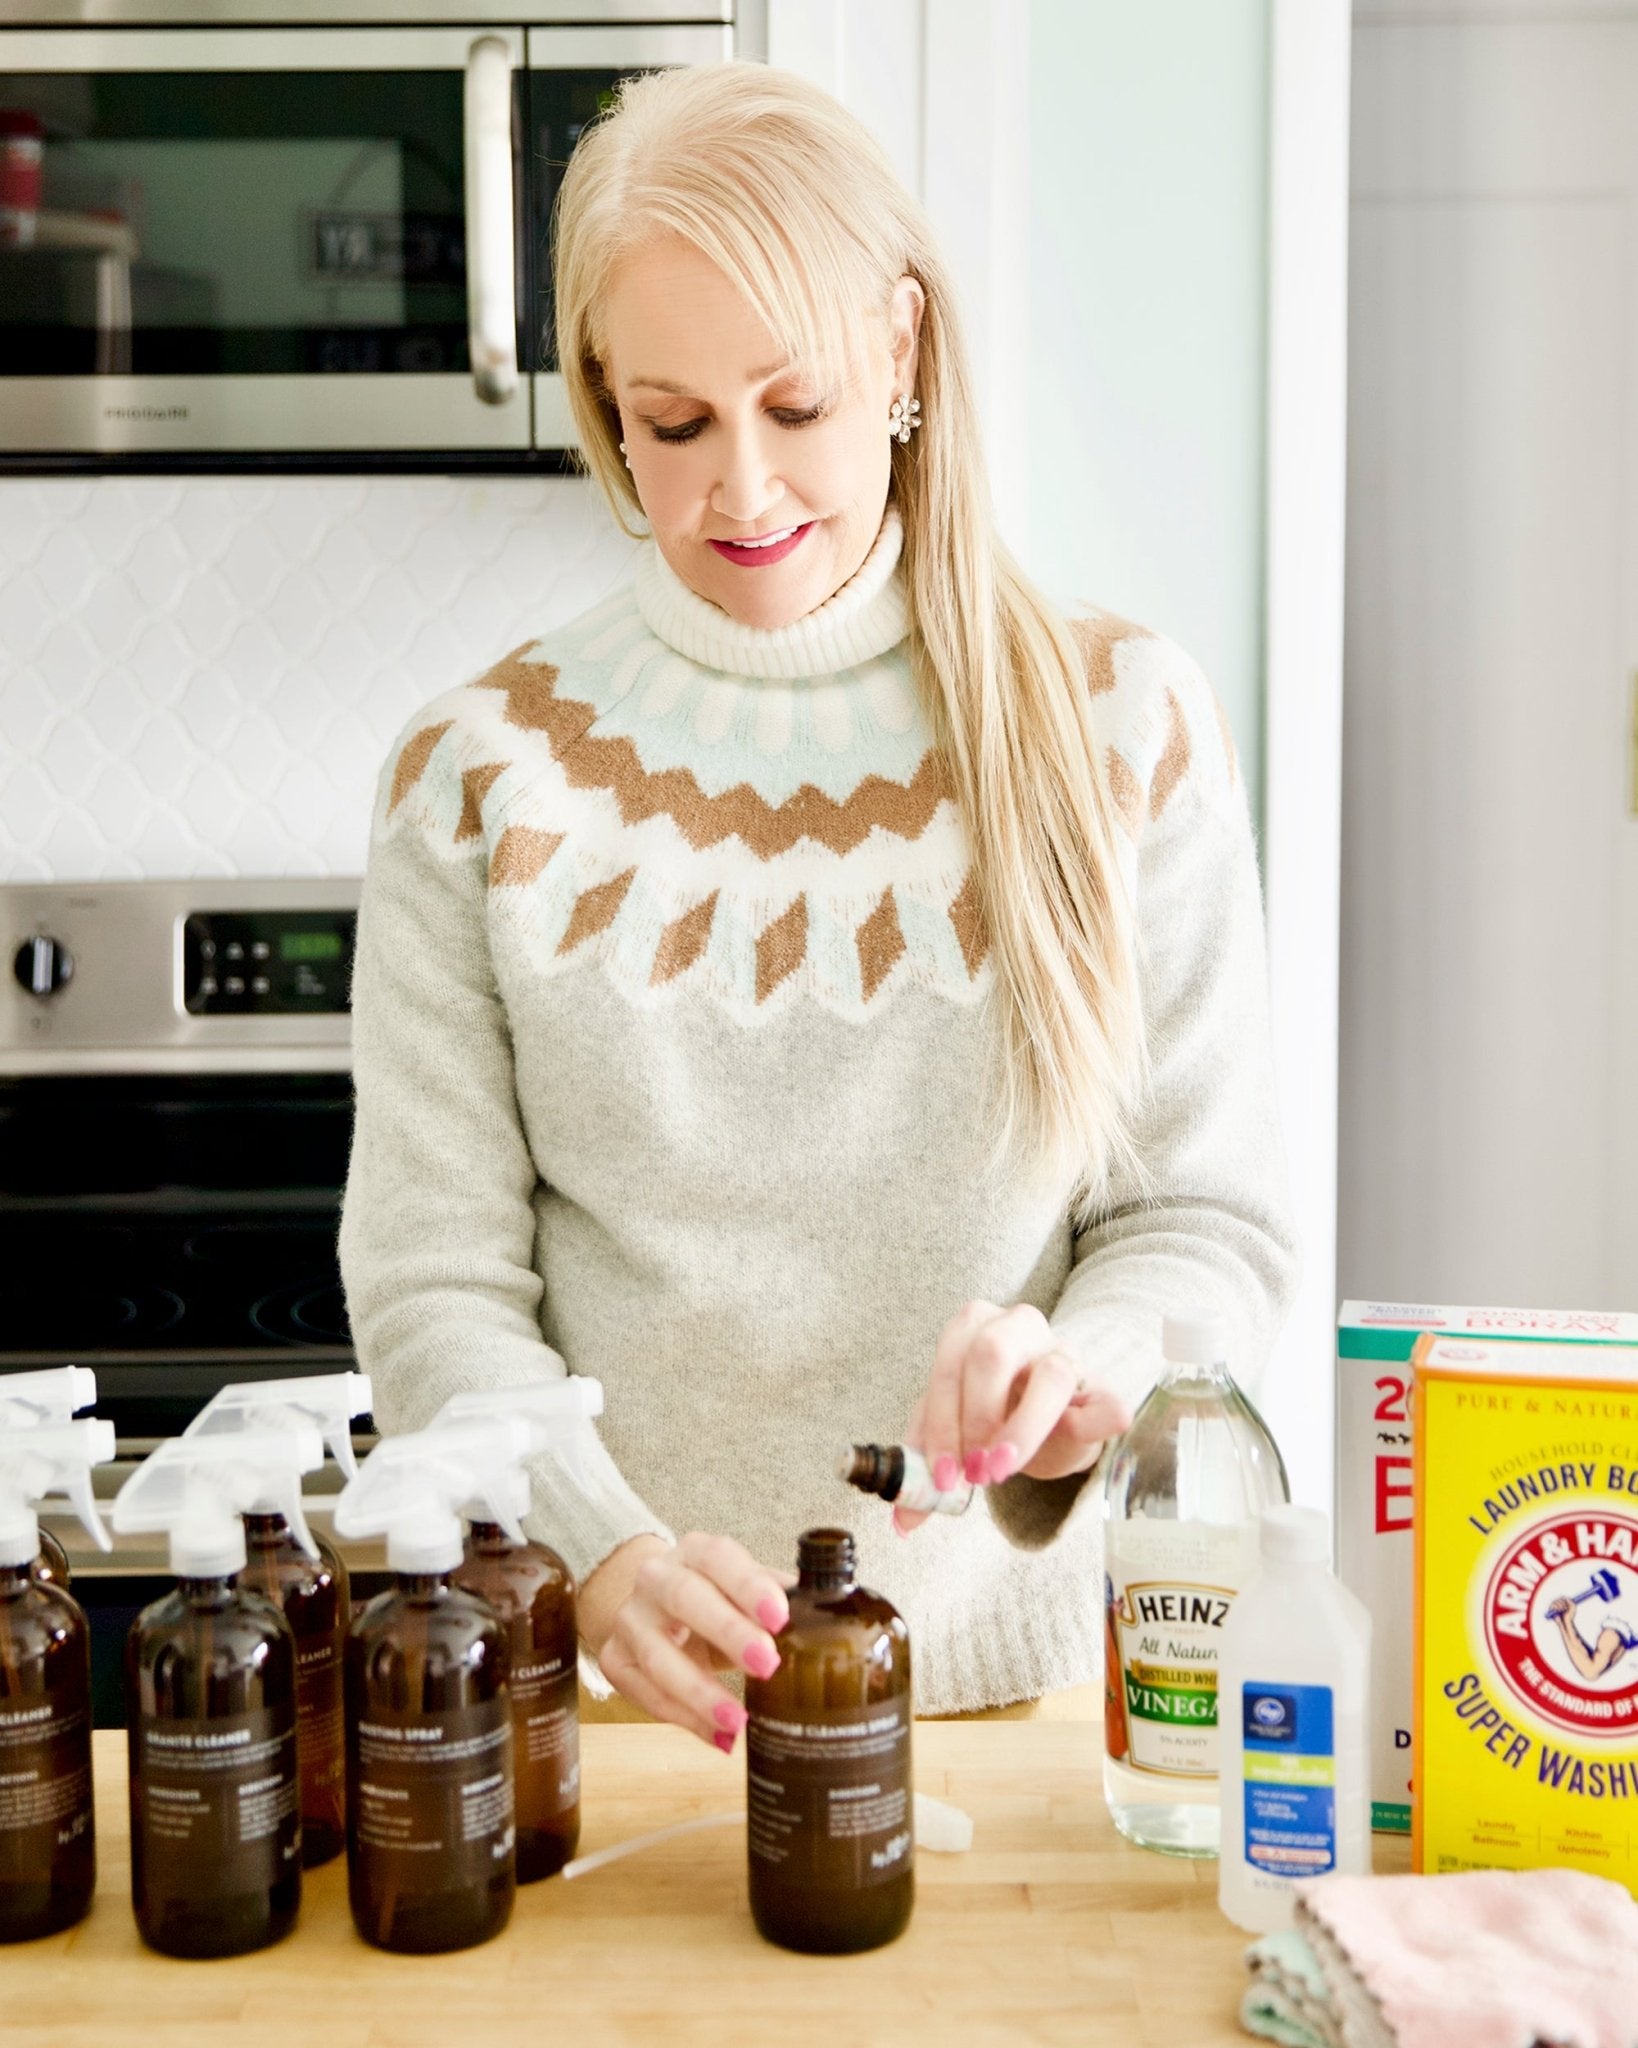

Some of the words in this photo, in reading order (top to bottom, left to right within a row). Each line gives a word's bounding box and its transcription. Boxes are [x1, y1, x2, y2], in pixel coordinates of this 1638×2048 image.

[1466, 1318, 1620, 1335] BORAX
[1374, 1376, 1413, 1421] 2
[1456, 1393, 1513, 1409] PURE
[1525, 1394, 1541, 1412] &
[1488, 1441, 1604, 1483] HOUSEHOLD
[1469, 1463, 1596, 1535] LAUNDRY
[1496, 1549, 1548, 1639] ARM
[1539, 1530, 1575, 1567] &
[1138, 1596, 1229, 1627] HEINZ
[1139, 1637, 1160, 1655] All
[1538, 1680, 1614, 1719] STANDARD
[1613, 1698, 1634, 1718] OF
[1443, 1673, 1531, 1770] SUPER
[1473, 1834, 1521, 1849] Bathroom
[1477, 1819, 1516, 1833] Laundry
[1565, 1827, 1603, 1841] Kitchen
